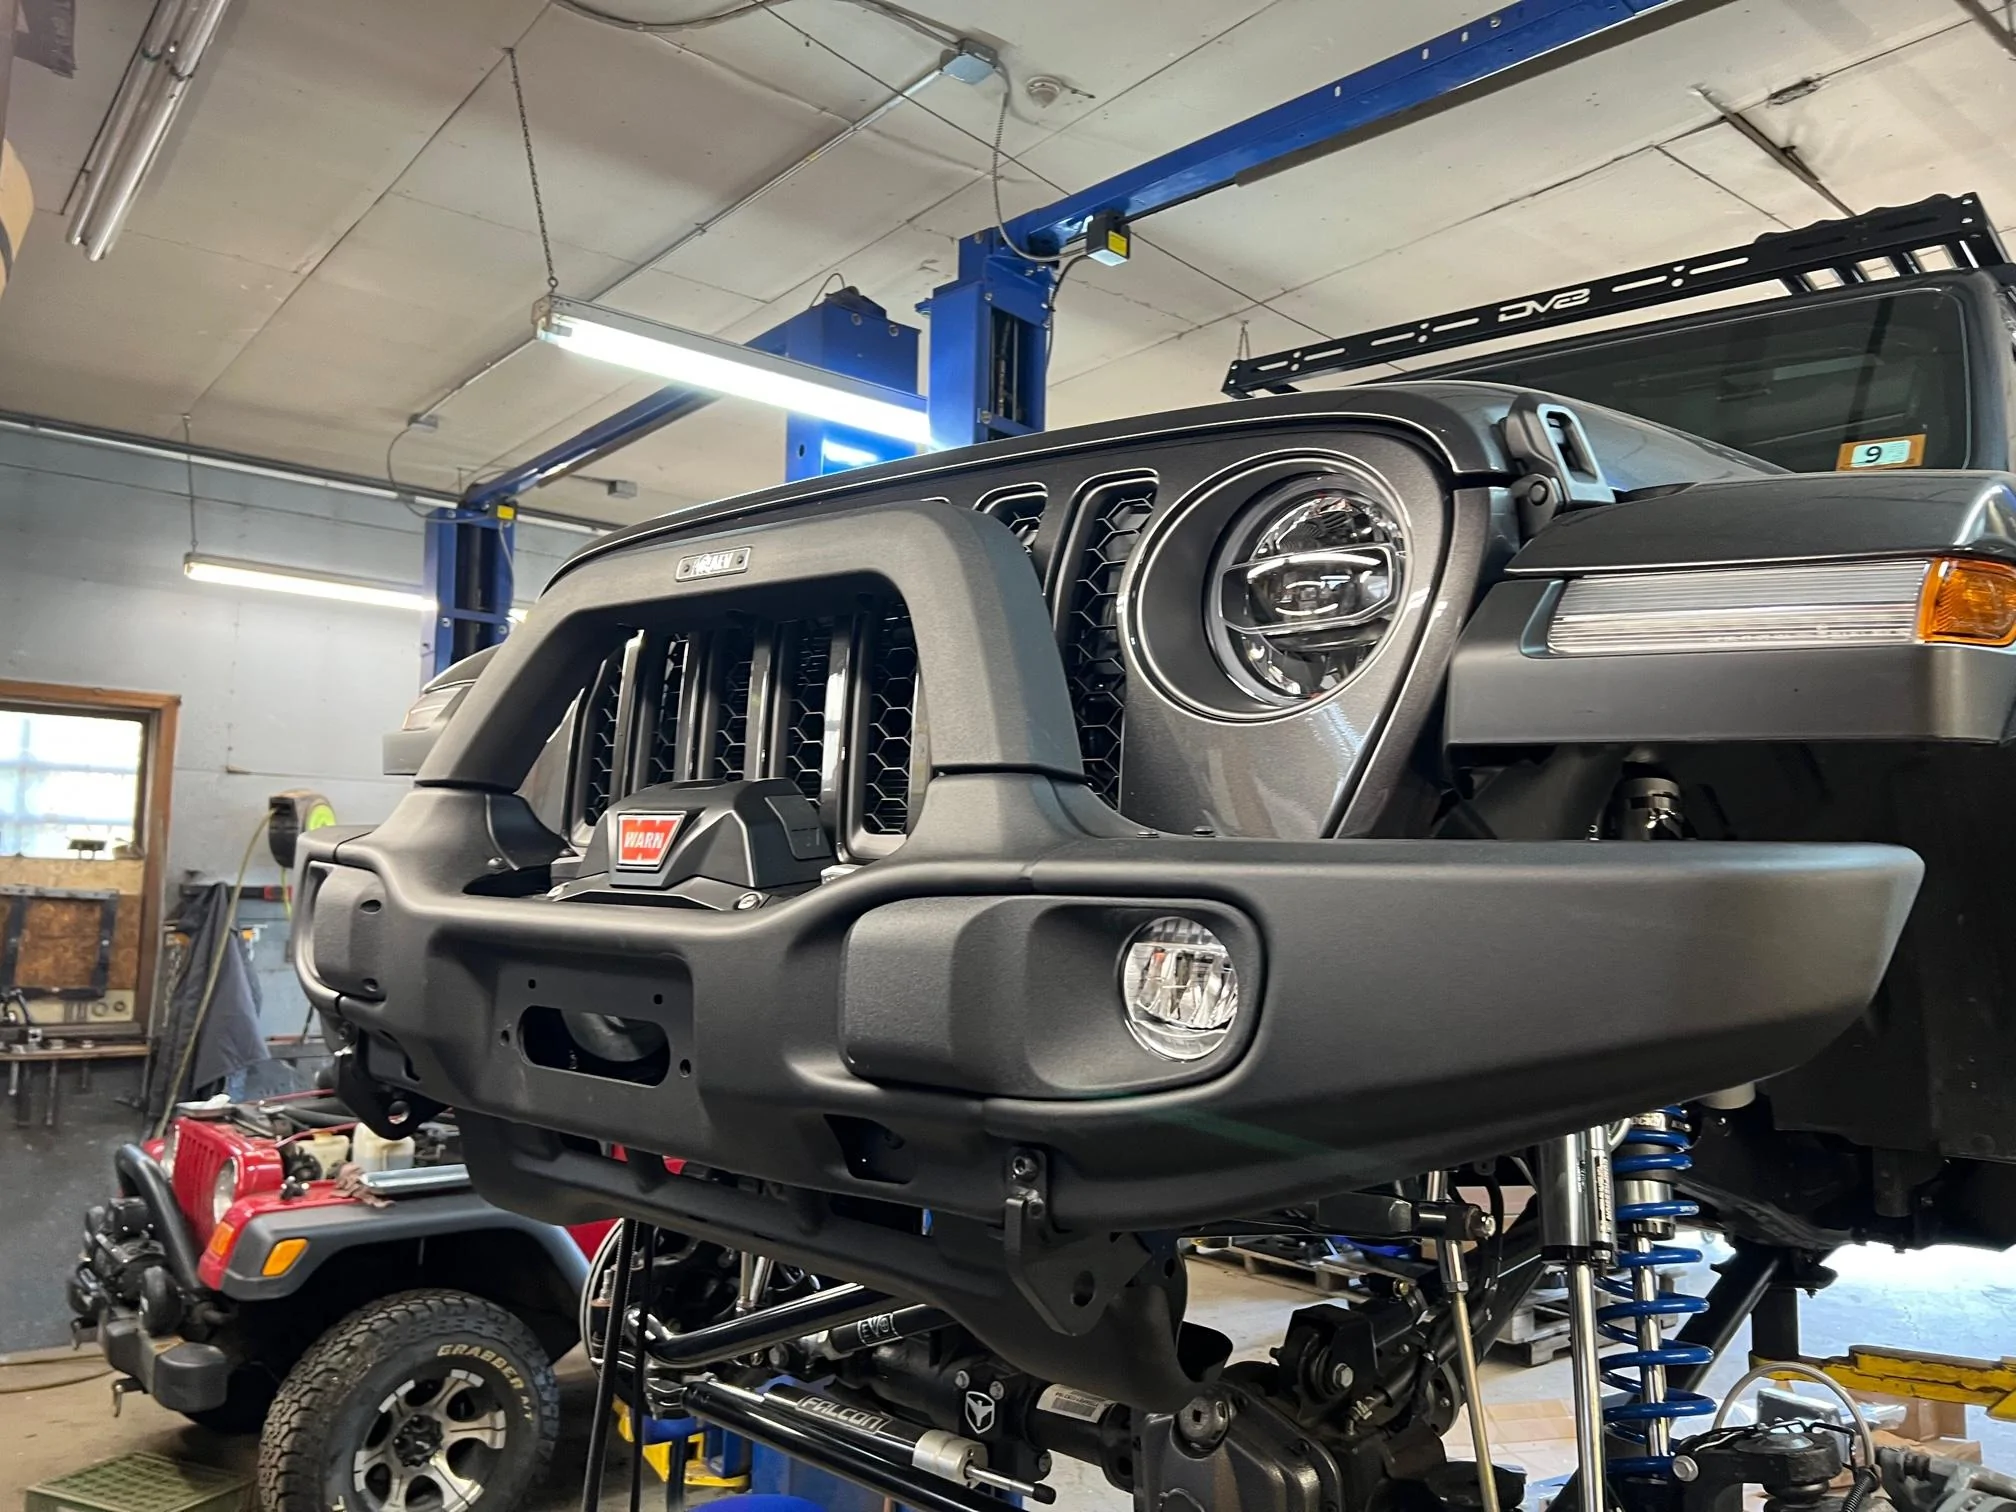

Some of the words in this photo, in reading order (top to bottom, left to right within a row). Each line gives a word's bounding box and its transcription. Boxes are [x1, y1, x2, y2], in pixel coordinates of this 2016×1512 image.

[1866, 445, 1883, 463] 9
[624, 832, 665, 849] WARN
[437, 1344, 525, 1389] GRABBER
[801, 1397, 884, 1429] FALCON
